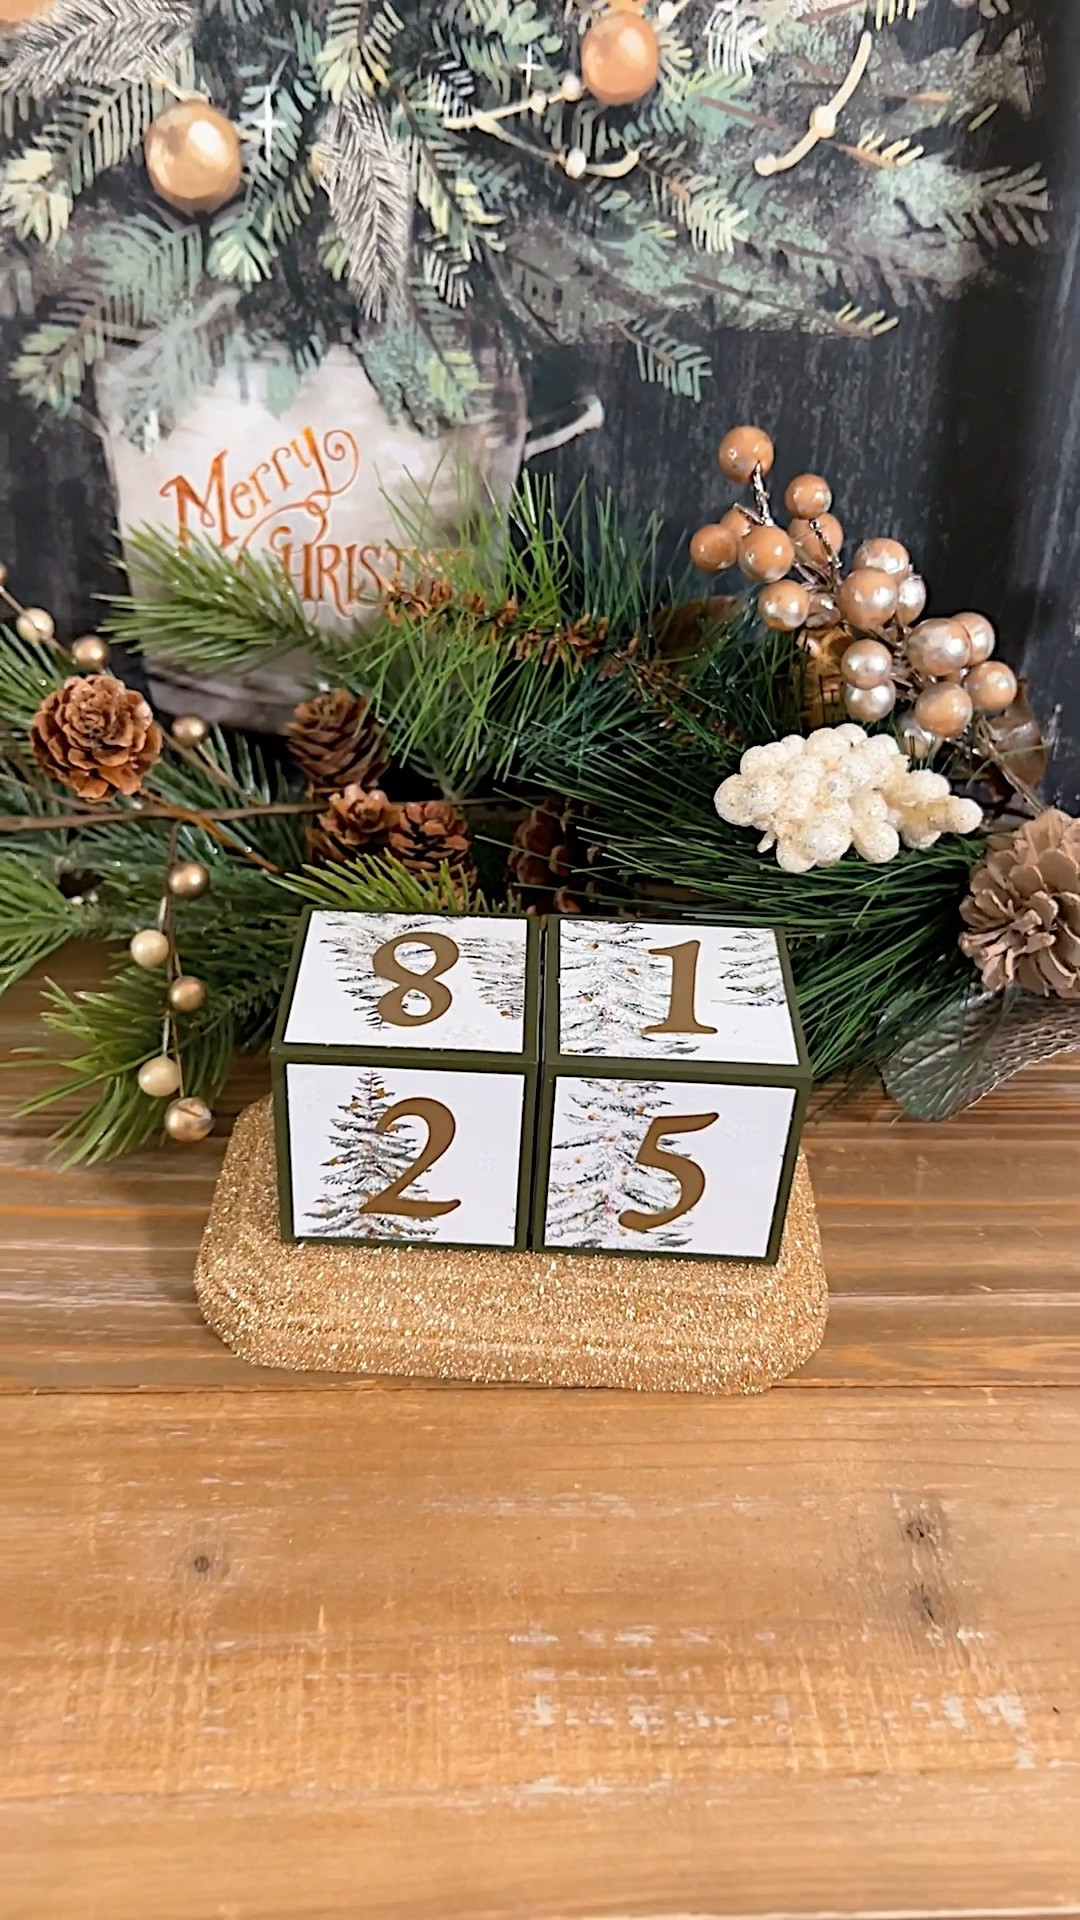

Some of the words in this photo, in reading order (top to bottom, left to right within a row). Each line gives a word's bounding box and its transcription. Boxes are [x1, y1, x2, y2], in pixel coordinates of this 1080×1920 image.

[159, 426, 360, 552] Merry
[372, 931, 460, 1027] 8
[643, 939, 718, 1035] 1
[359, 1096, 462, 1217] 2
[618, 1111, 720, 1232] 5
